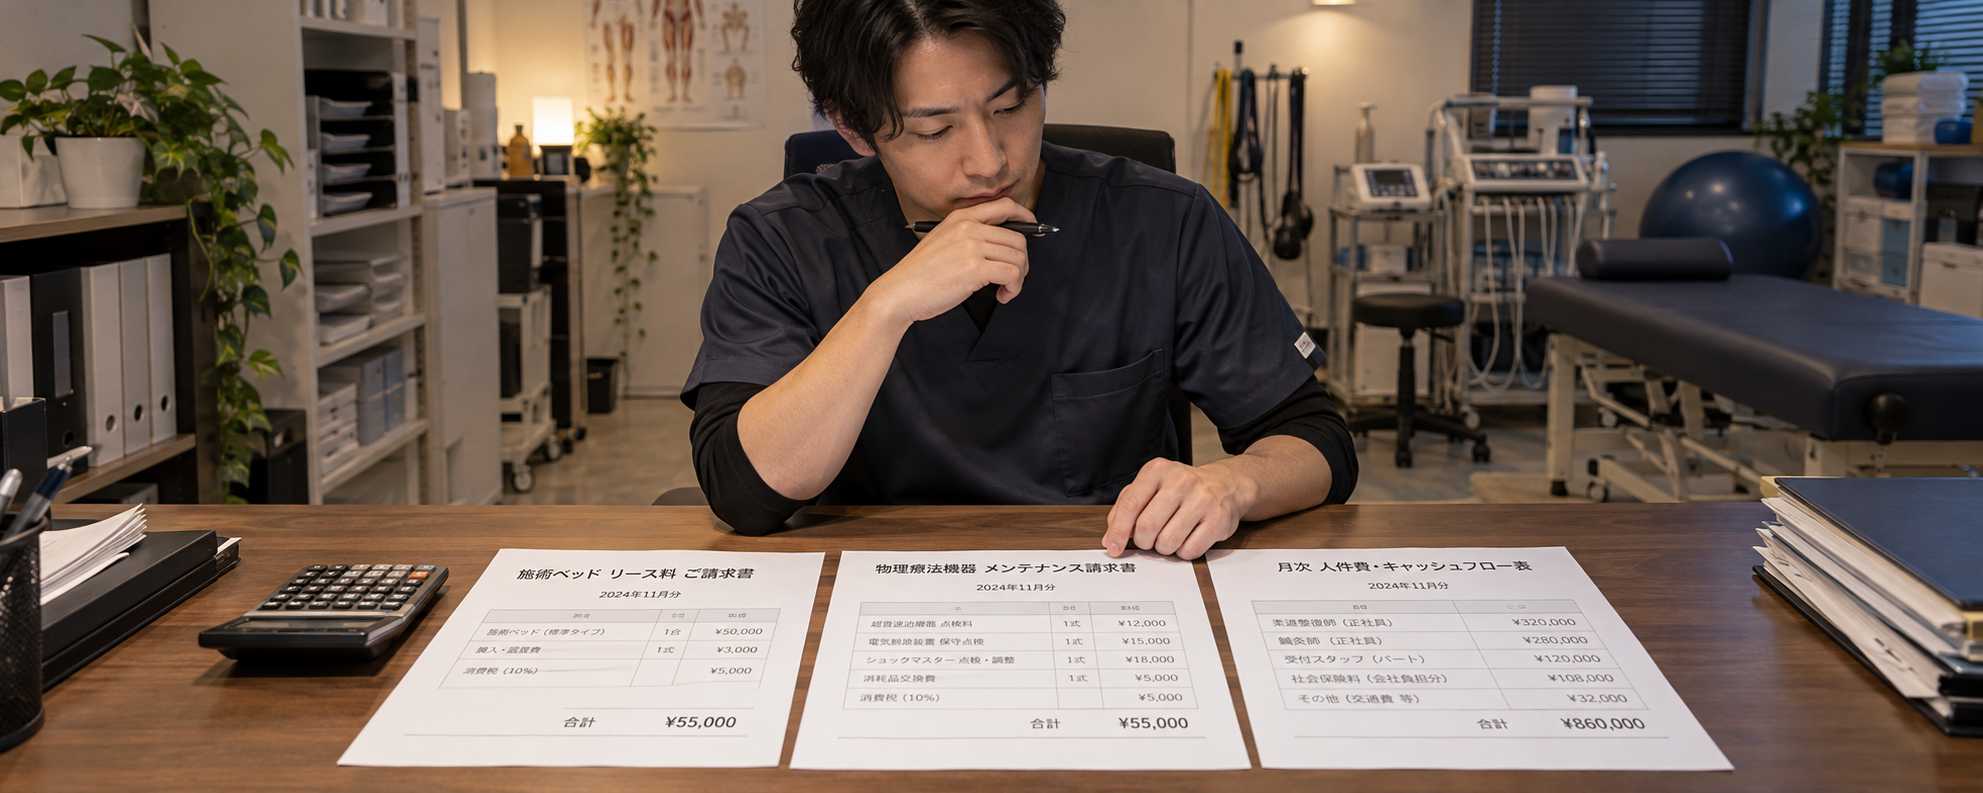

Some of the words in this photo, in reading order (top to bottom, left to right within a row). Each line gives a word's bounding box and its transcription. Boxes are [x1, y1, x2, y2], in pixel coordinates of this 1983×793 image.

[874, 563, 977, 575] 物理療法機器
[984, 562, 1136, 574] メンテナンス請求書
[1277, 561, 1312, 573] 月次
[1319, 560, 1533, 572] 人件費・キャッシュフロー表
[516, 567, 602, 581] 施術ベッド
[609, 567, 676, 580] リース料
[684, 567, 755, 580] ご請求書
[976, 583, 1056, 591] 2024年11月分
[1367, 581, 1449, 590] 2024年11月分
[598, 590, 682, 599] 2024年11月分
[1117, 619, 1167, 627] ¥12,000
[1511, 618, 1577, 626] ¥320,000
[715, 627, 764, 635] ¥50,000
[1121, 637, 1171, 646] ¥15,000
[1521, 636, 1589, 646] ¥280,000
[716, 646, 759, 655] ¥3,000
[1124, 655, 1177, 664] ¥18,000
[1533, 654, 1601, 664] ¥120,000
[710, 666, 753, 675] ¥5,000
[1134, 673, 1179, 682] ¥5,000
[1546, 673, 1615, 683] ¥108,000
[1138, 692, 1183, 702] ¥5,000
[1565, 693, 1628, 703] ¥32,000
[563, 716, 597, 728] 合計
[664, 716, 737, 729] ¥55,000
[1029, 717, 1061, 729] 合計
[1117, 716, 1189, 730] ¥55,000
[1476, 717, 1509, 729] 合計
[1559, 717, 1648, 731] ¥860,000
